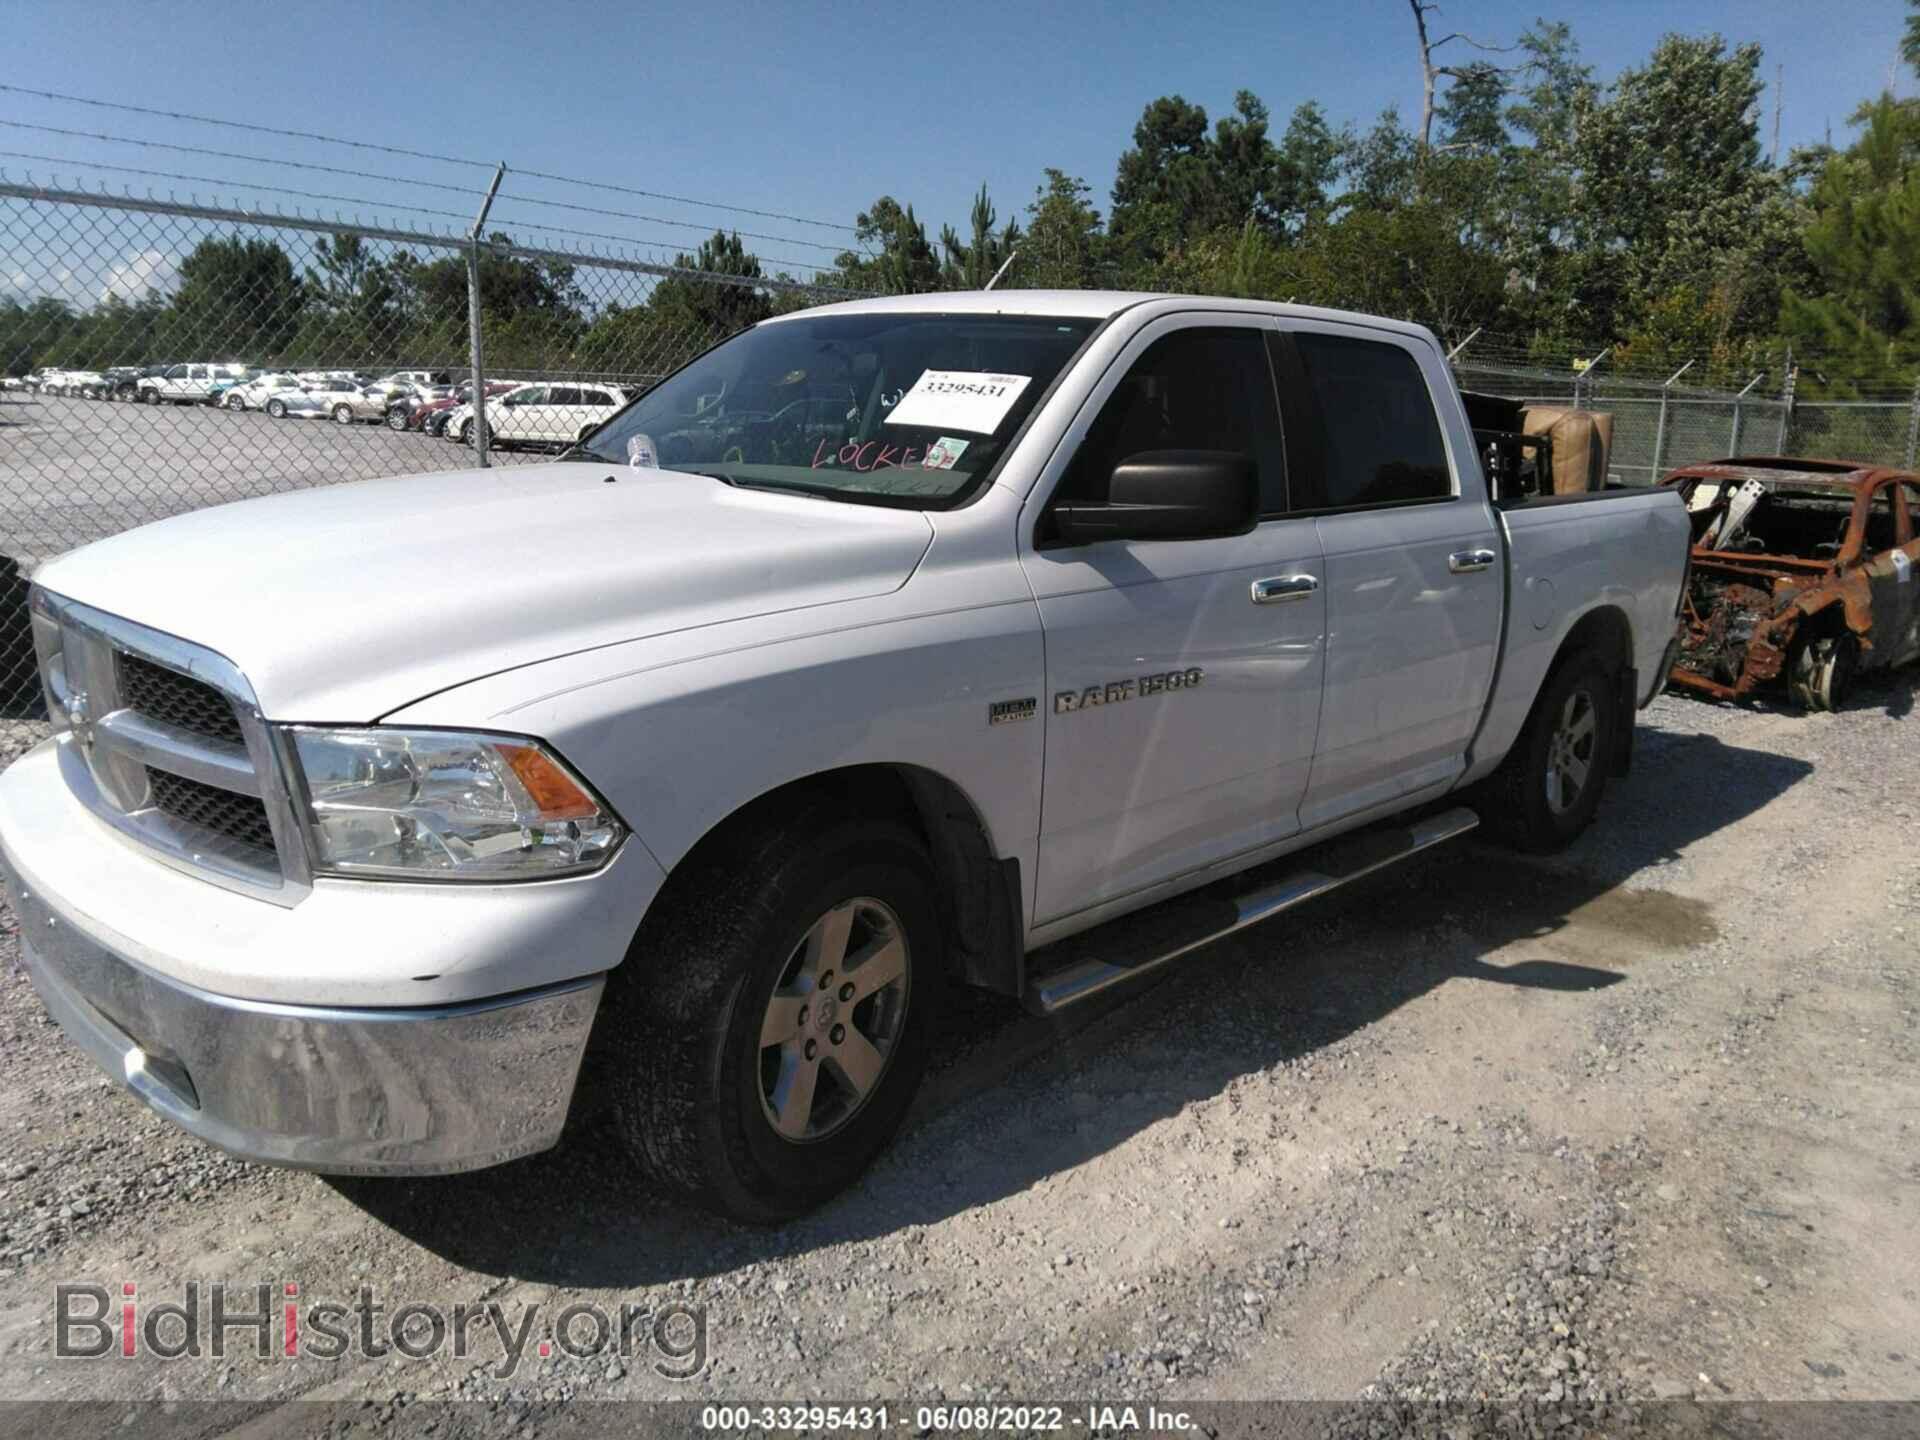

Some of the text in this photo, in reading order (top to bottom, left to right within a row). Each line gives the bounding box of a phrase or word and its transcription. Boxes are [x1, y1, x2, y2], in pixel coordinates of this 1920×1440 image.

[921, 382, 1007, 398] 33295431
[812, 438, 948, 471] LOCKED
[1055, 667, 1205, 714] RAM 1500
